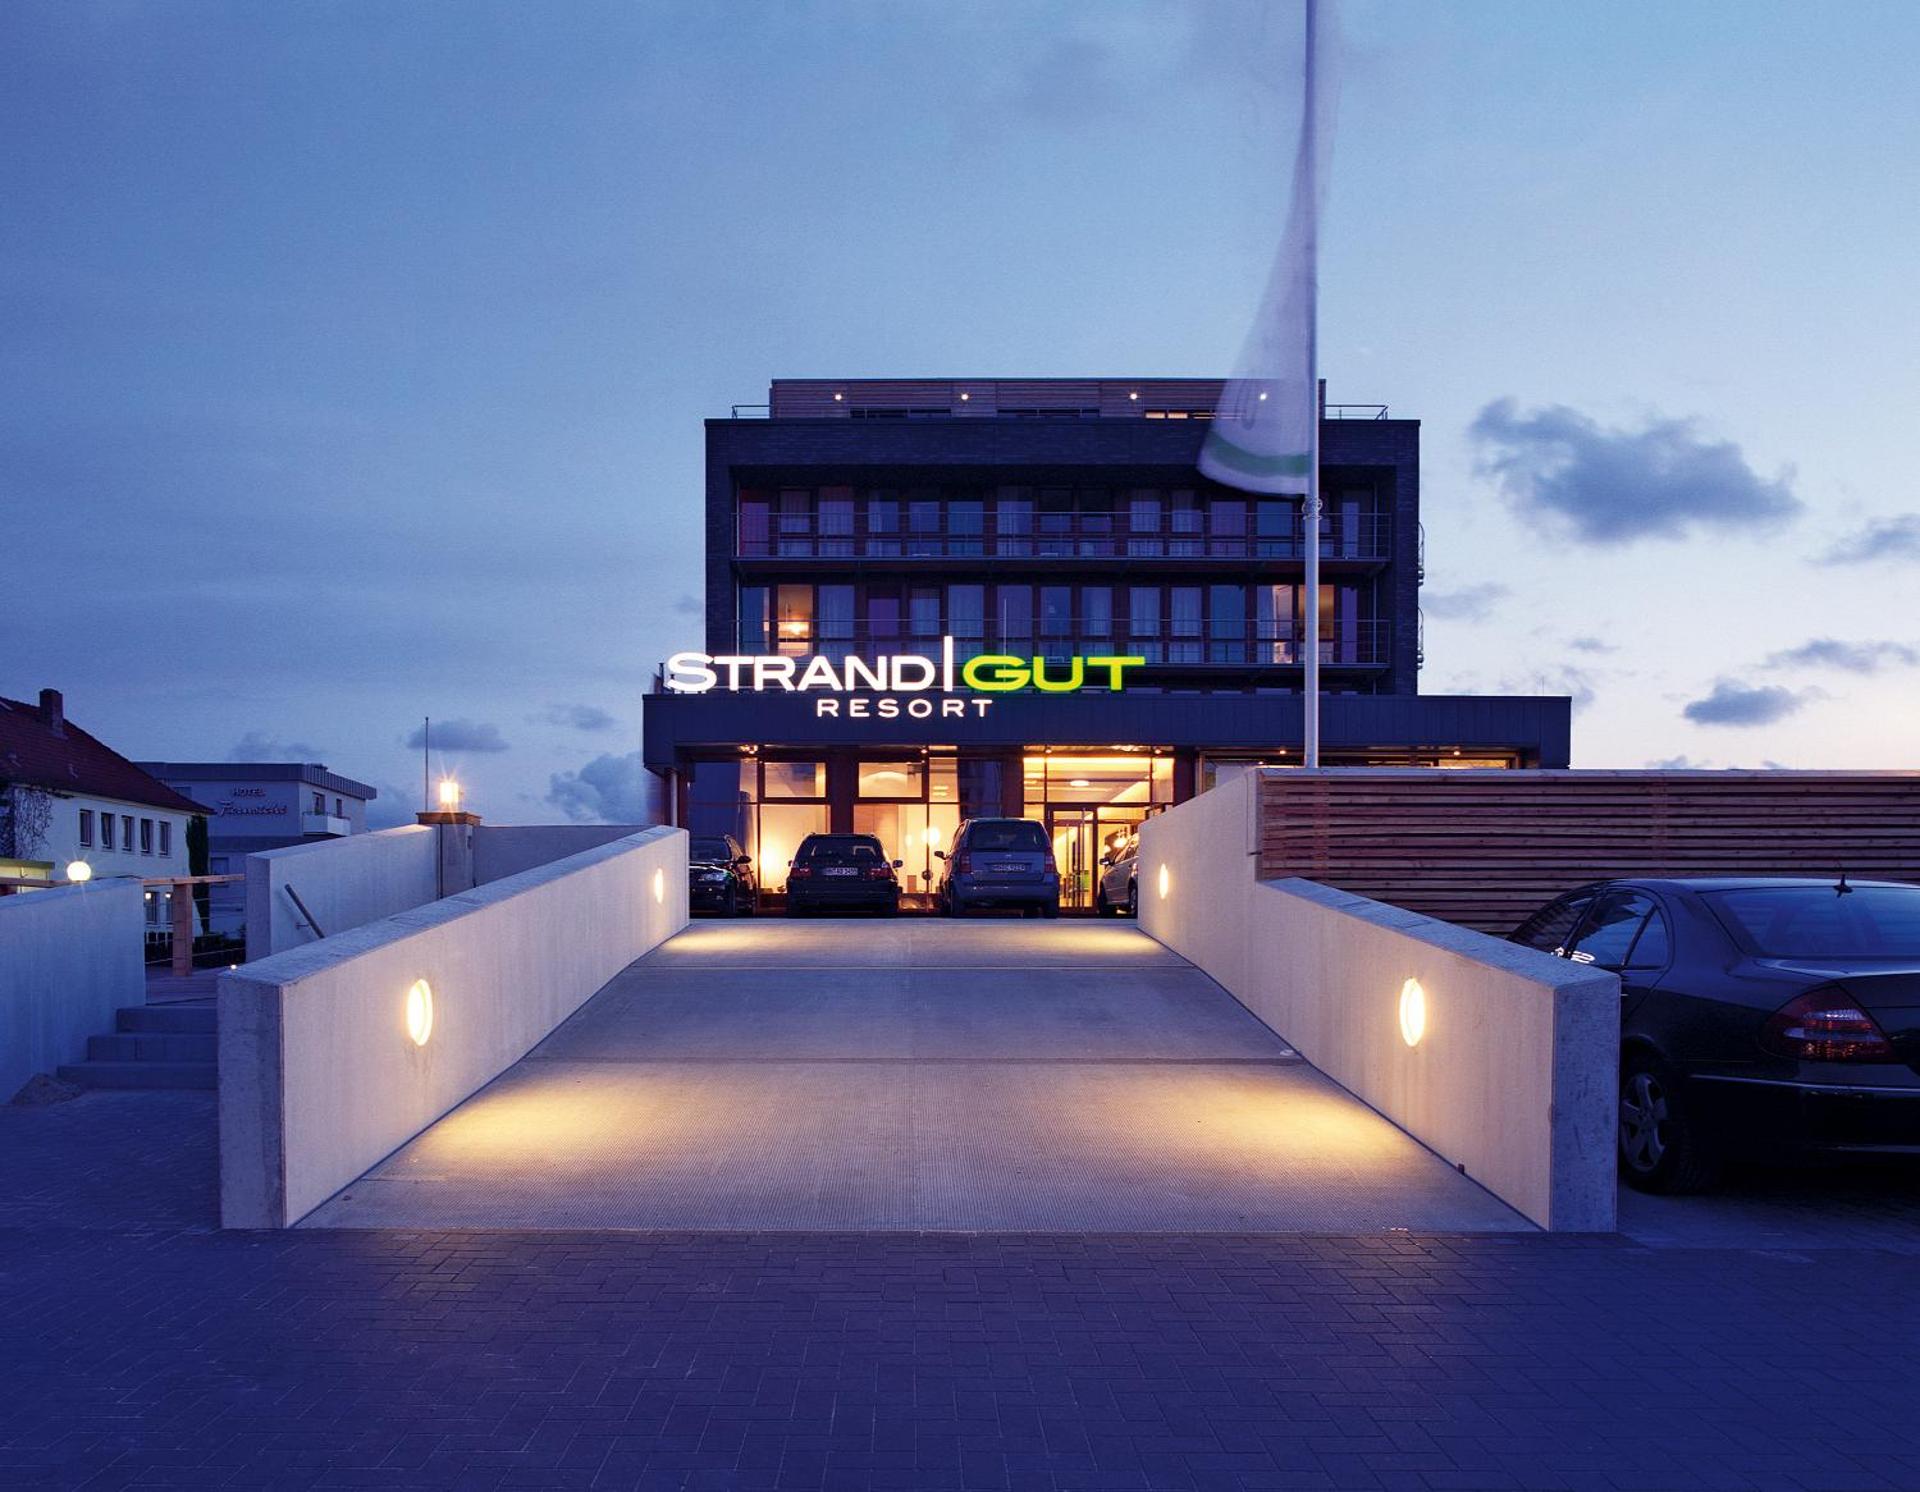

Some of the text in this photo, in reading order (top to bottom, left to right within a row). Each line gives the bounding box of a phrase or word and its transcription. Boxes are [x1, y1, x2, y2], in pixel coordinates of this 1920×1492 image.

[667, 652, 1146, 693] STRAND GUT
[816, 698, 993, 718] RESORT
[232, 786, 267, 797] HOTEL
